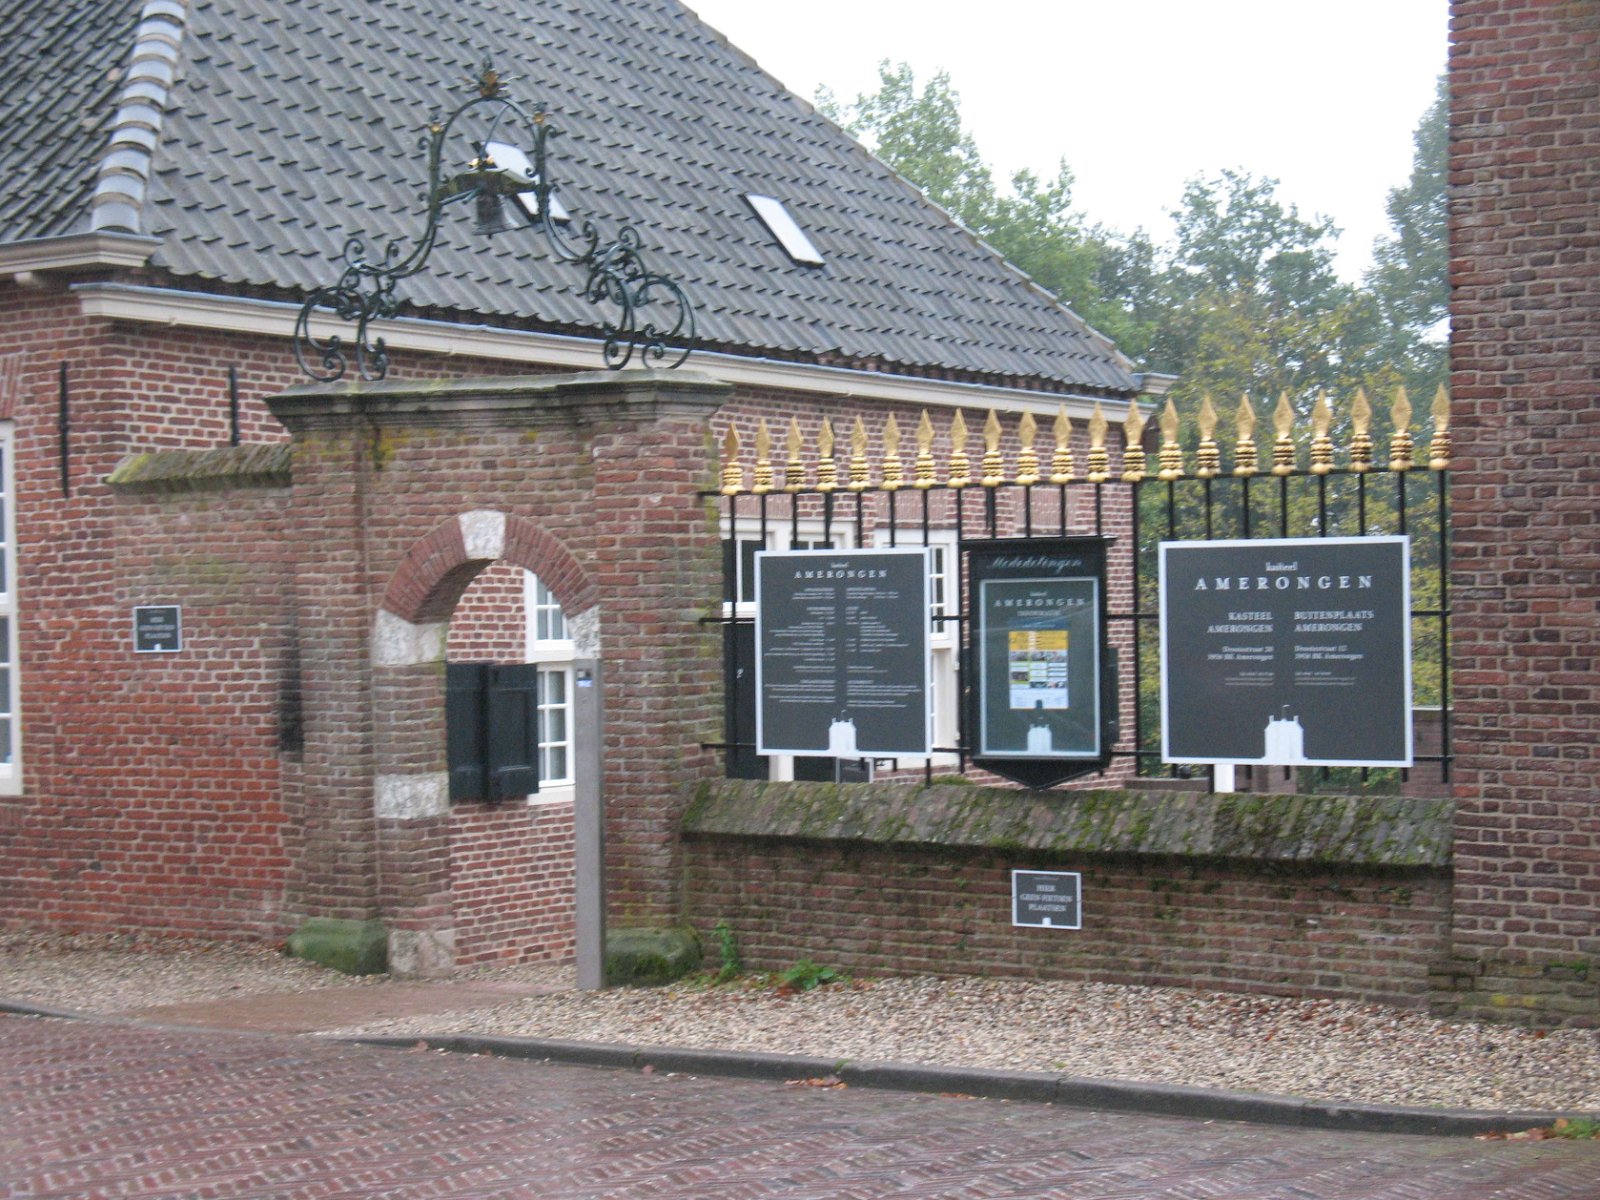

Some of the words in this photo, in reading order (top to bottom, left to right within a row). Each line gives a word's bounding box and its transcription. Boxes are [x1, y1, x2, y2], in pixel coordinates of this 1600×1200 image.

[991, 556, 1082, 574] Mededelingen
[1265, 561, 1298, 571] kasteel
[794, 570, 888, 579] AMERONGEN
[1195, 576, 1373, 590] AMERONGEN
[993, 598, 1086, 607] AMERONGEN
[1228, 611, 1273, 621] KASTEEL
[1294, 610, 1375, 620] BUITENPLAATS
[1206, 624, 1273, 633] AMERONGEN
[1294, 622, 1363, 632] AMERONGEN
